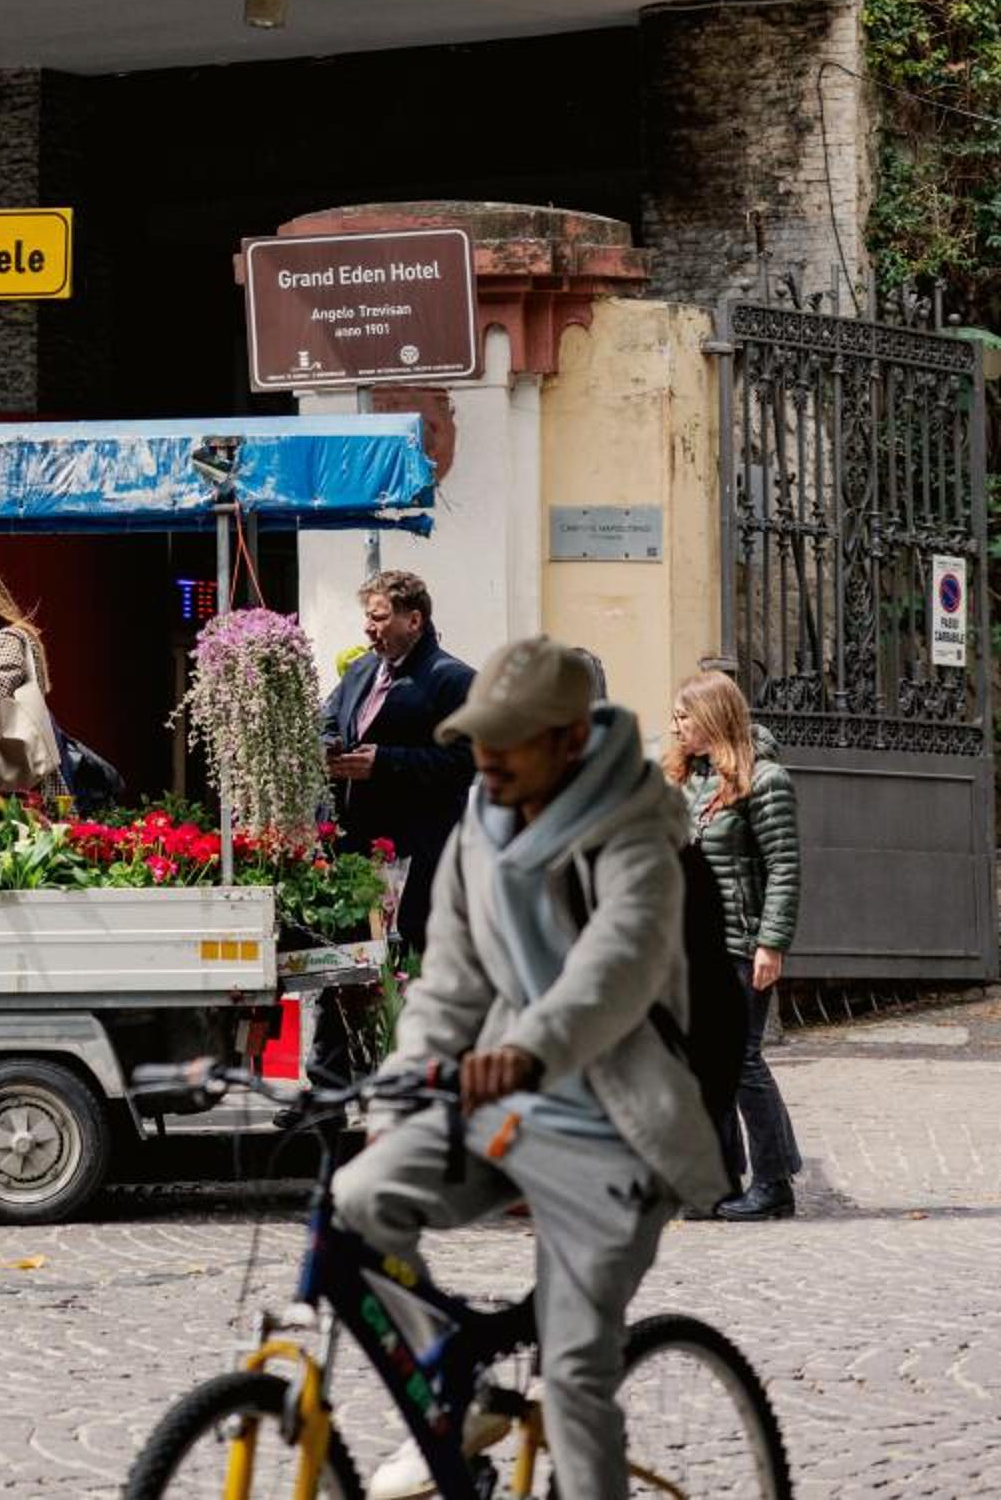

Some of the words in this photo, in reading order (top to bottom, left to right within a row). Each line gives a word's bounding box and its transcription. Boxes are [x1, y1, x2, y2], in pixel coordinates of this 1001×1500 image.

[278, 268, 334, 288] Grand
[339, 264, 386, 284] Eden
[390, 260, 440, 281] Hotel
[311, 305, 355, 322] Angelo
[359, 303, 412, 318] Trevisan
